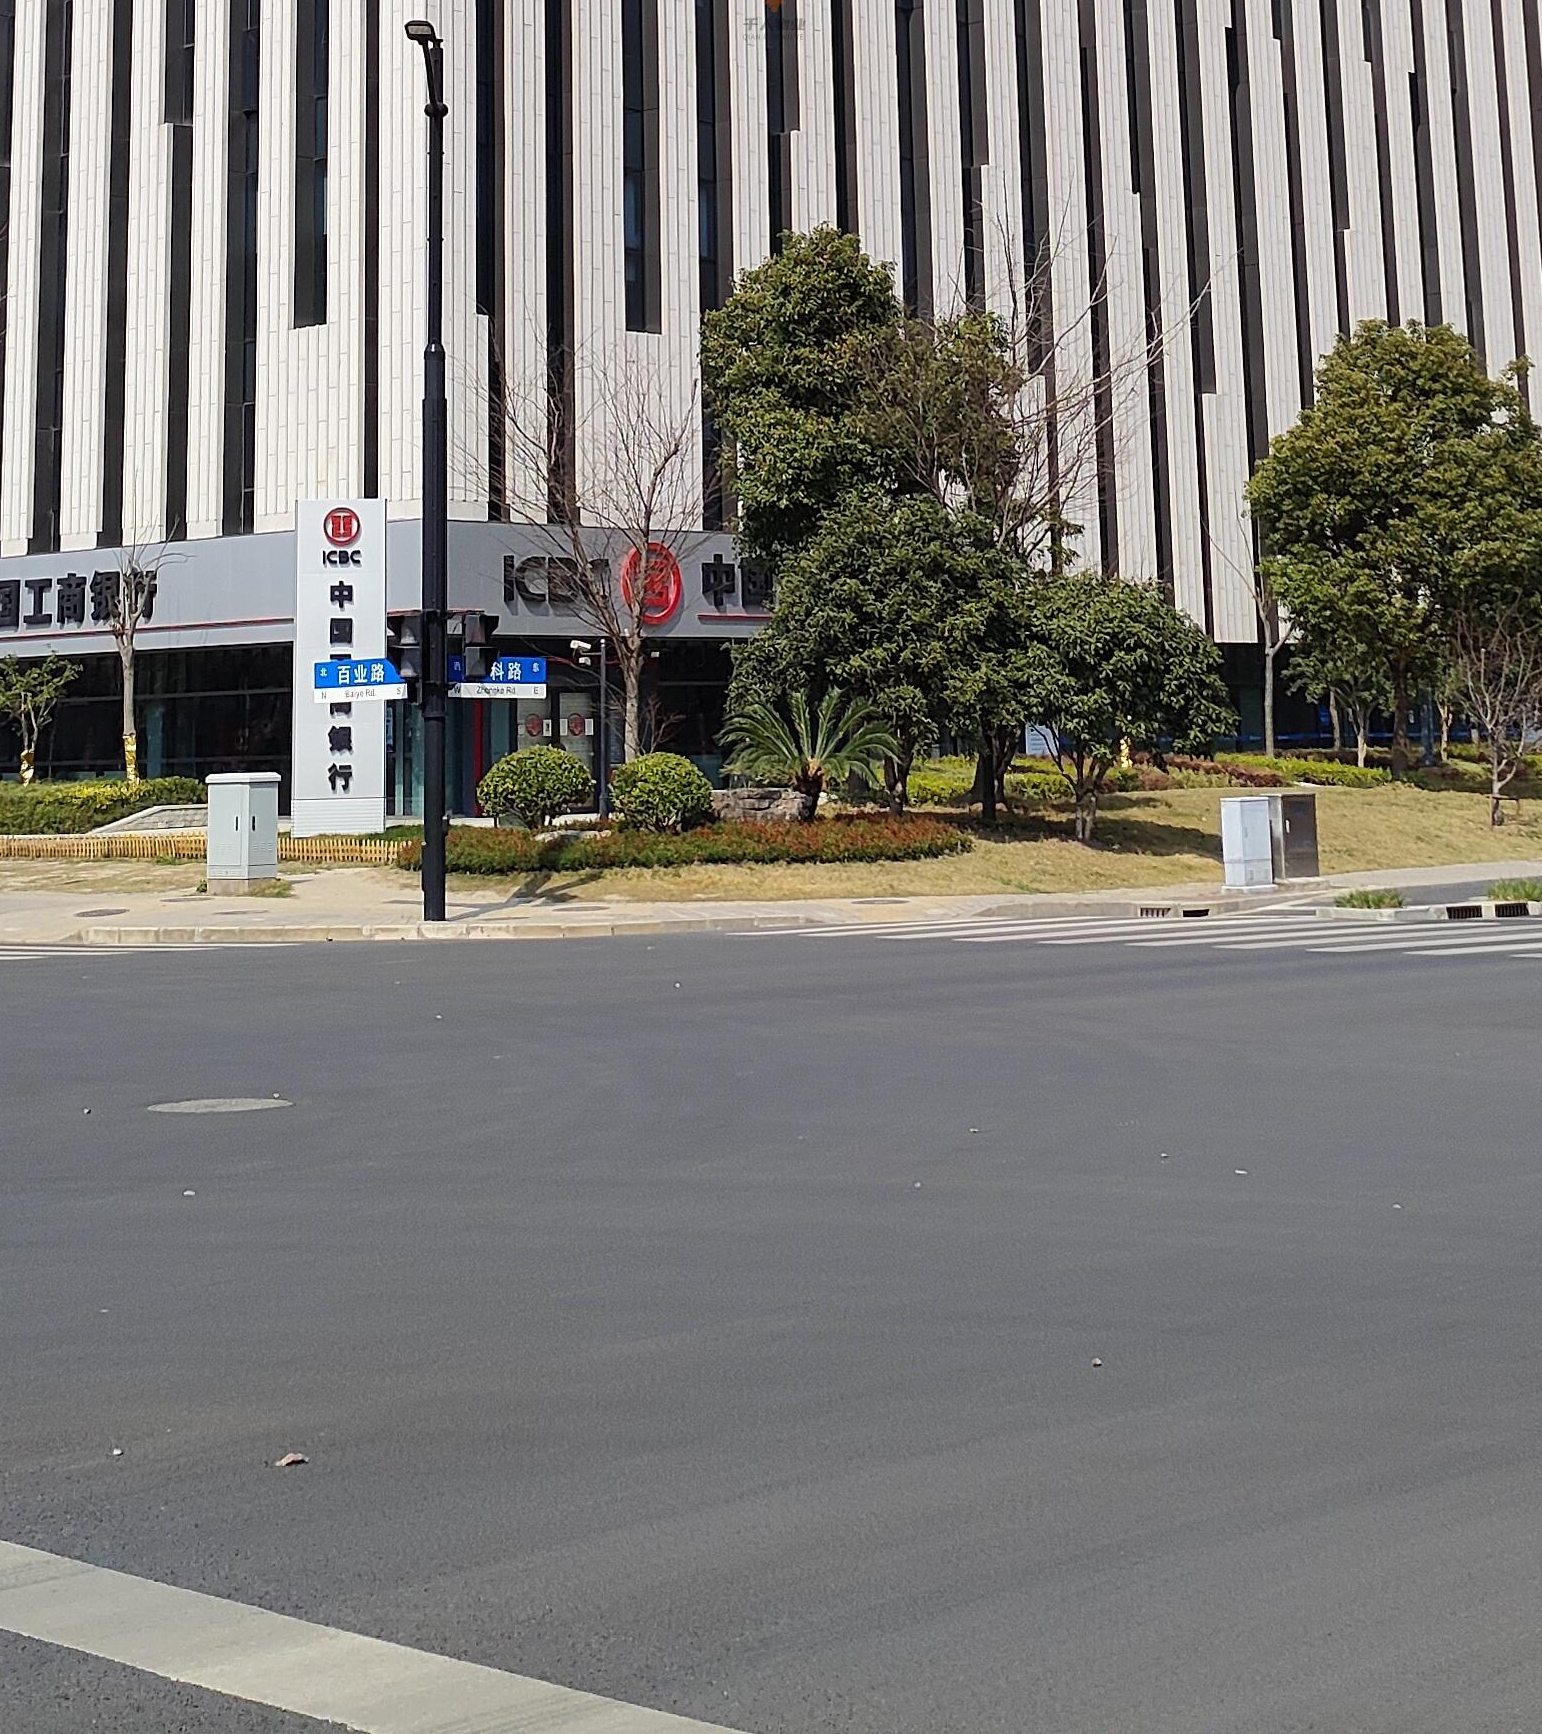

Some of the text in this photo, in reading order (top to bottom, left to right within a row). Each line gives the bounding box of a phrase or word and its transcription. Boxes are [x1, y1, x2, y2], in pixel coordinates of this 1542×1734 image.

[323, 550, 361, 565] ICBC
[320, 663, 384, 684] 北 百业路
[490, 661, 521, 682] 科路
[322, 691, 327, 699] N
[396, 687, 401, 695] S
[328, 581, 353, 790] 中国银行
